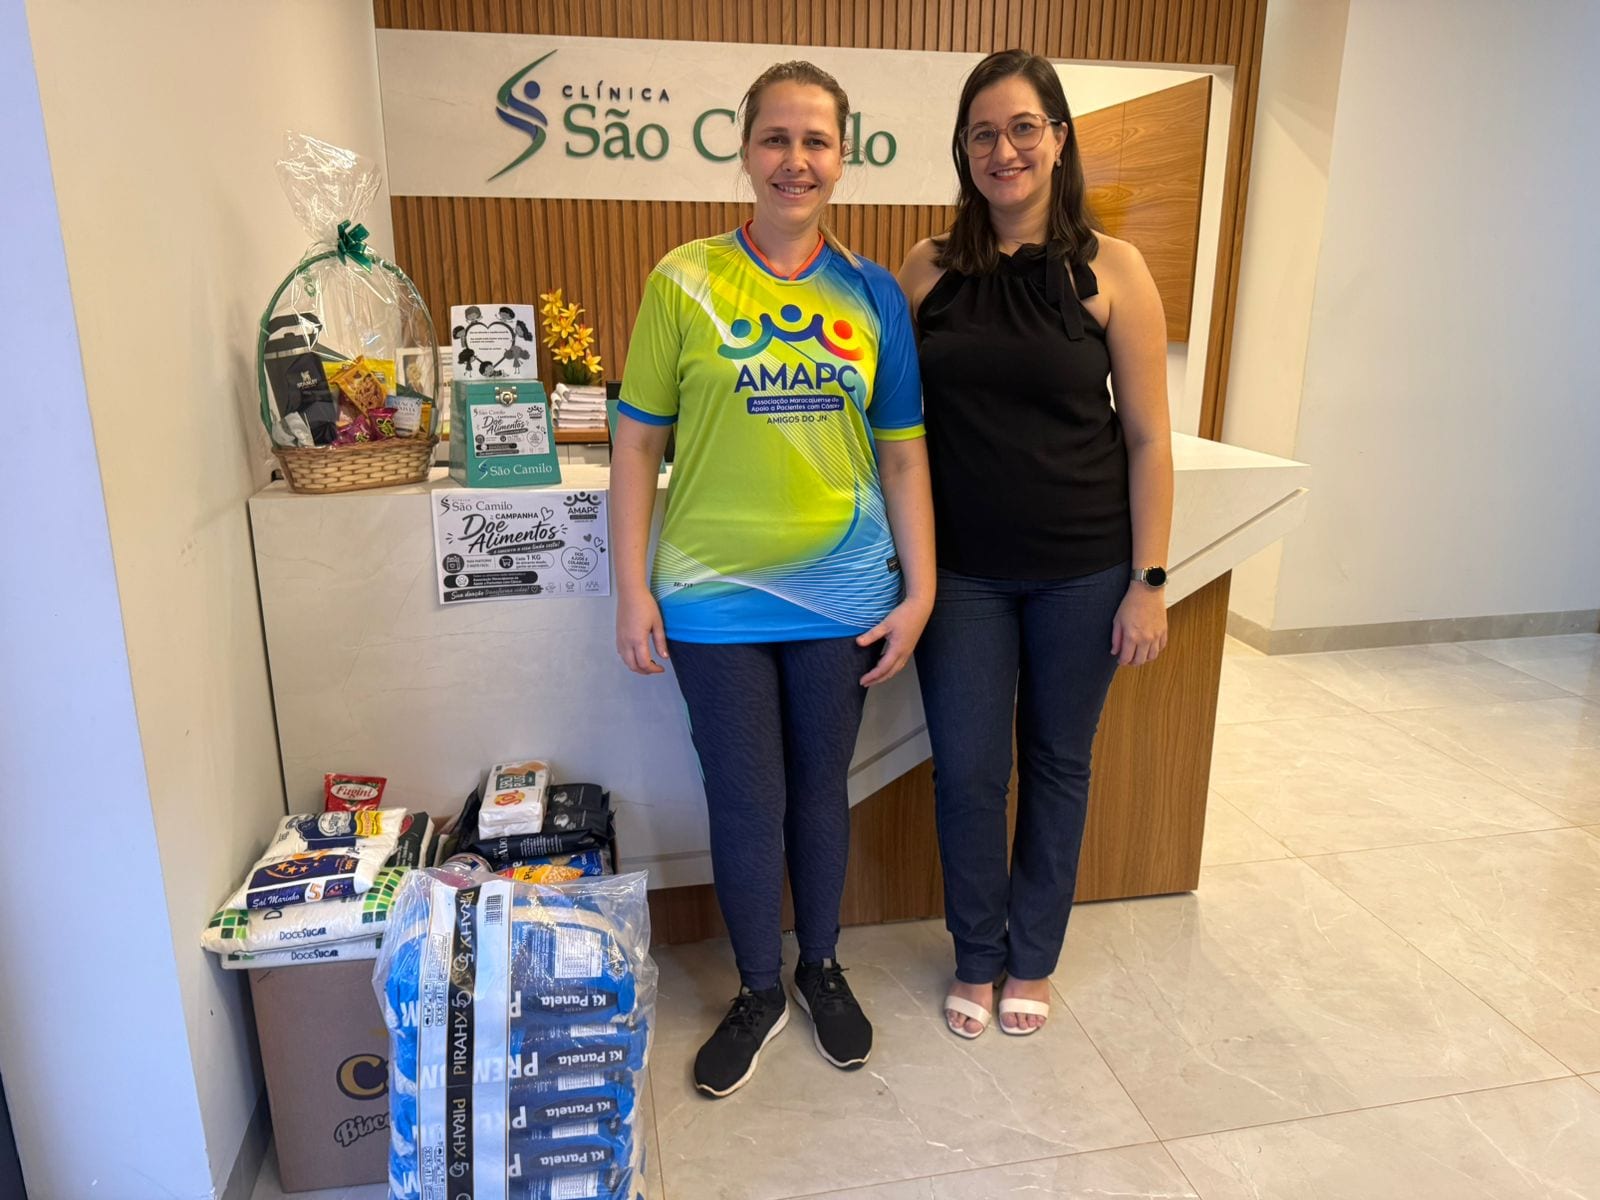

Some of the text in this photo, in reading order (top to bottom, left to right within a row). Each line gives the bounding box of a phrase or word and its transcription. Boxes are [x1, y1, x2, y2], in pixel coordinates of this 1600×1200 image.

[562, 80, 670, 102] CLÍNICA
[563, 103, 898, 168] São Clo
[734, 362, 858, 393] AMAPC
[753, 397, 788, 405] Associação
[486, 419, 526, 436] Alimentos
[767, 415, 800, 425] AMIGOS
[816, 414, 827, 422] JN
[489, 463, 553, 477] São Camilo
[452, 501, 513, 512] São Camilo
[568, 506, 599, 514] AMAPC
[495, 512, 539, 520] CAMPANHA
[457, 513, 510, 540] Doe
[468, 520, 560, 554] Alimentos
[336, 785, 373, 799] Fugini
[252, 894, 300, 910] Sal Marinho
[540, 994, 607, 1008] Ki Panela
[453, 1011, 468, 1076] PIRAHY
[557, 1049, 623, 1066] Ki Panela
[545, 1100, 611, 1118] Ki Panela
[452, 1098, 467, 1158] PIRAHY
[540, 1150, 605, 1167] Ki Panela
